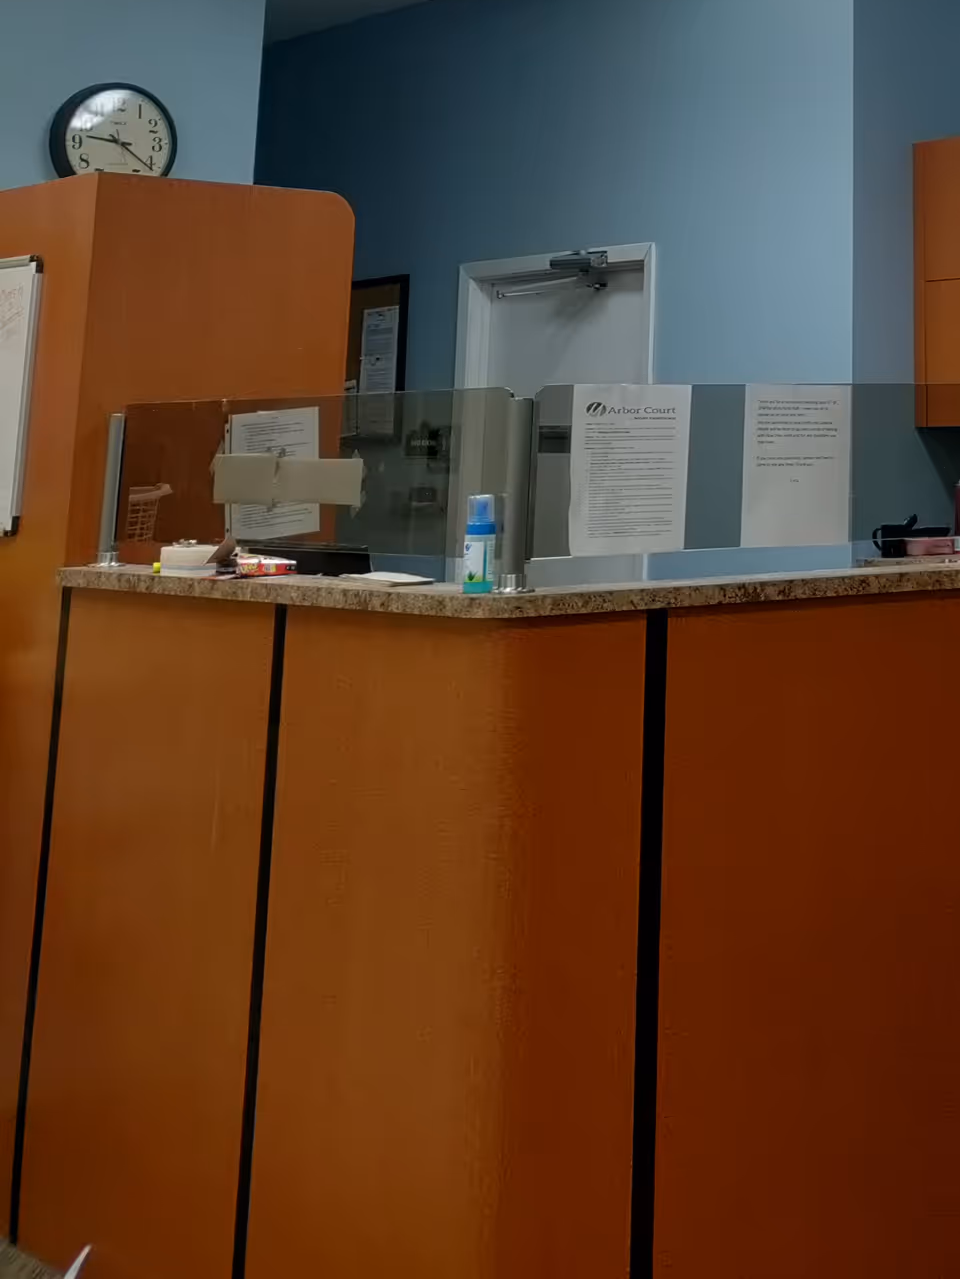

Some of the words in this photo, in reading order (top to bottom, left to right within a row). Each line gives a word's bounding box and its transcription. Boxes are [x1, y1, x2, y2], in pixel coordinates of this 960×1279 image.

[137, 103, 142, 119] 1
[148, 118, 159, 135] 2
[71, 134, 83, 151] 9
[151, 136, 163, 153] 3
[78, 152, 90, 170] 8
[145, 154, 156, 172] 4
[608, 406, 641, 414] Arbor
[644, 406, 676, 414] Court
